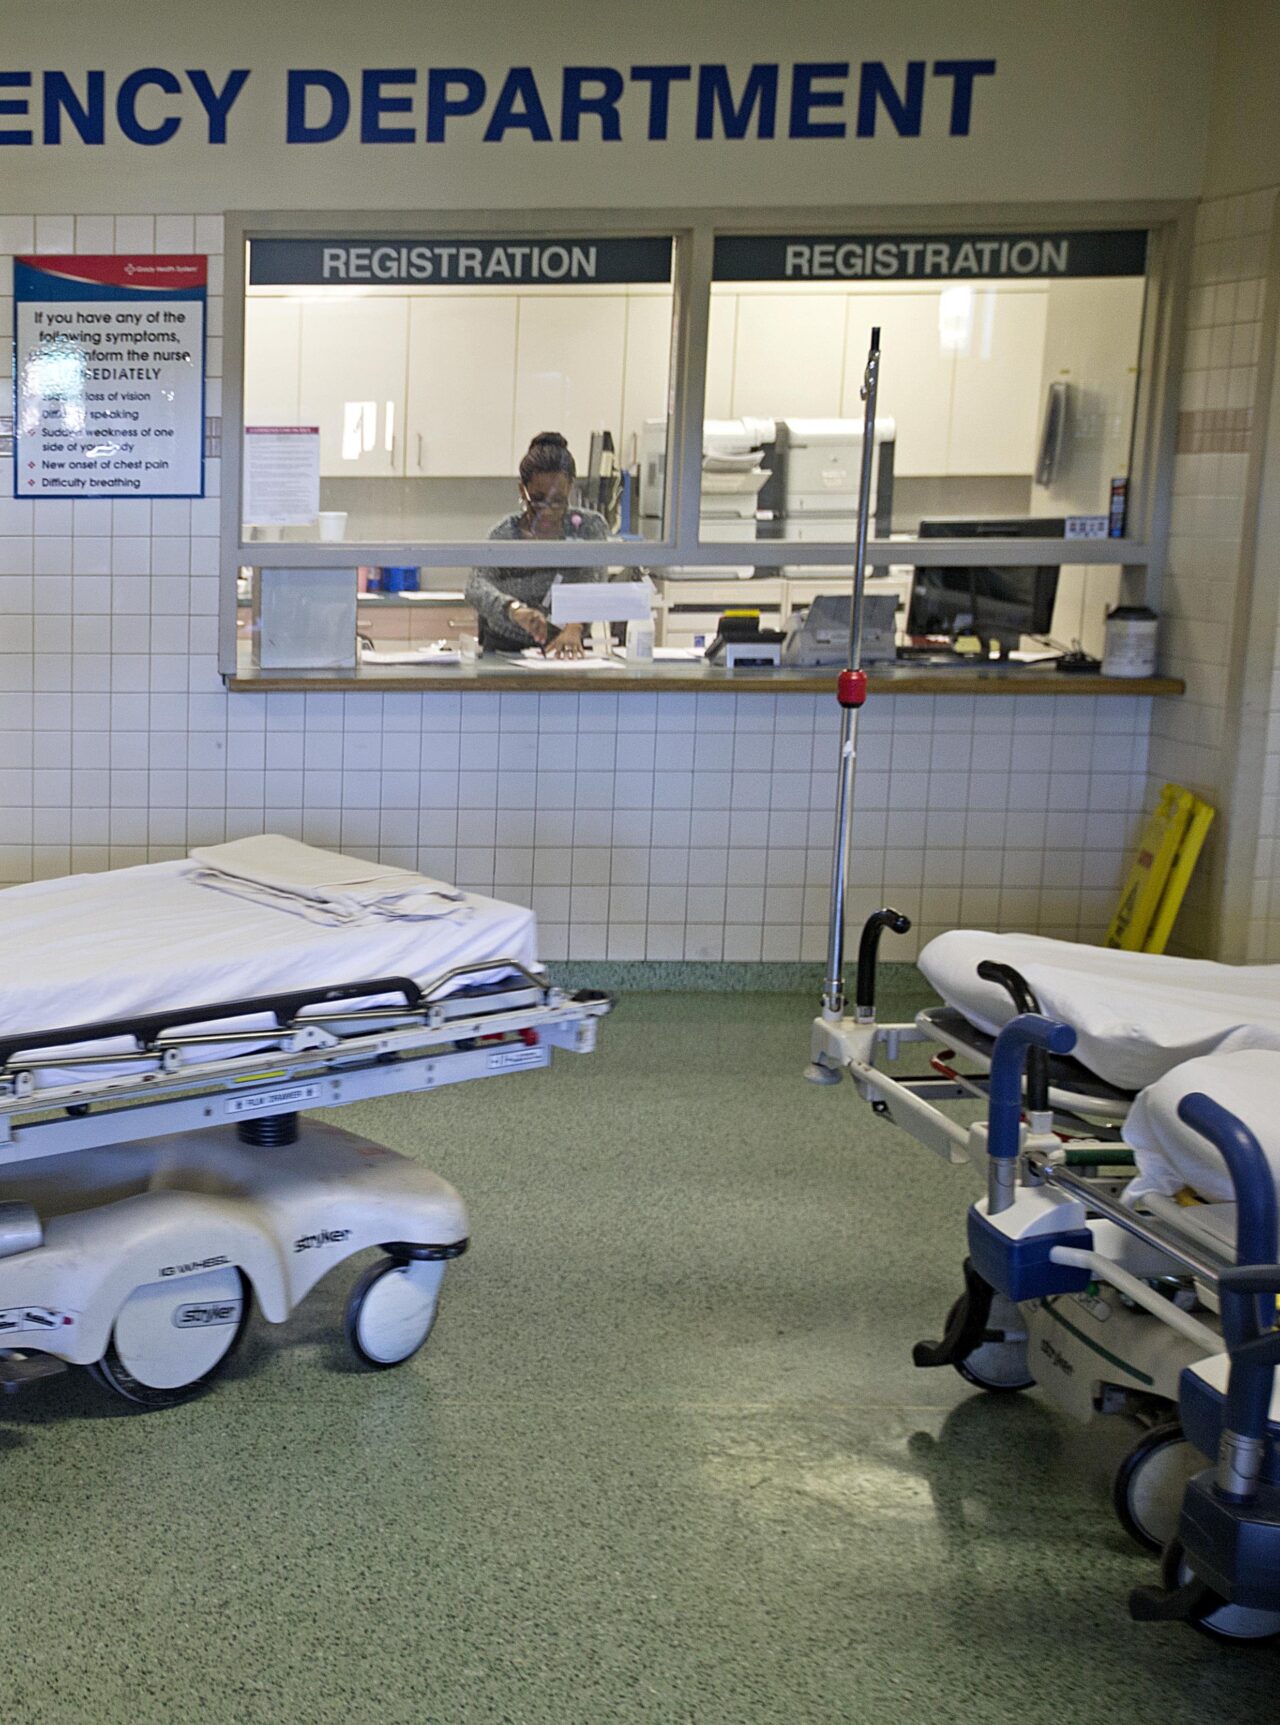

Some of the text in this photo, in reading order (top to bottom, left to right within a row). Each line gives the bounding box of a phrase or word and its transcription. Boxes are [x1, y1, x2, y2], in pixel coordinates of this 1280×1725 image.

[285, 59, 997, 146] DEPARTMENT
[322, 246, 597, 280] REGISTRATION
[784, 240, 1069, 277] REGISTRATION
[34, 311, 186, 326] If you have any of the
[105, 331, 181, 344] symptoms,
[127, 349, 149, 361] the
[153, 351, 191, 362] nurse
[85, 391, 106, 401] loss
[108, 391, 119, 401] of
[120, 391, 151, 401] vision
[90, 409, 139, 421] speaking
[86, 427, 138, 438] weakness
[140, 427, 153, 438] of
[154, 429, 174, 438] one
[42, 442, 64, 452] side
[66, 442, 79, 452] of
[41, 460, 169, 472] New onset of chest pain
[41, 477, 141, 489] Difficulty breathing
[181, 1305, 236, 1324] stryker
